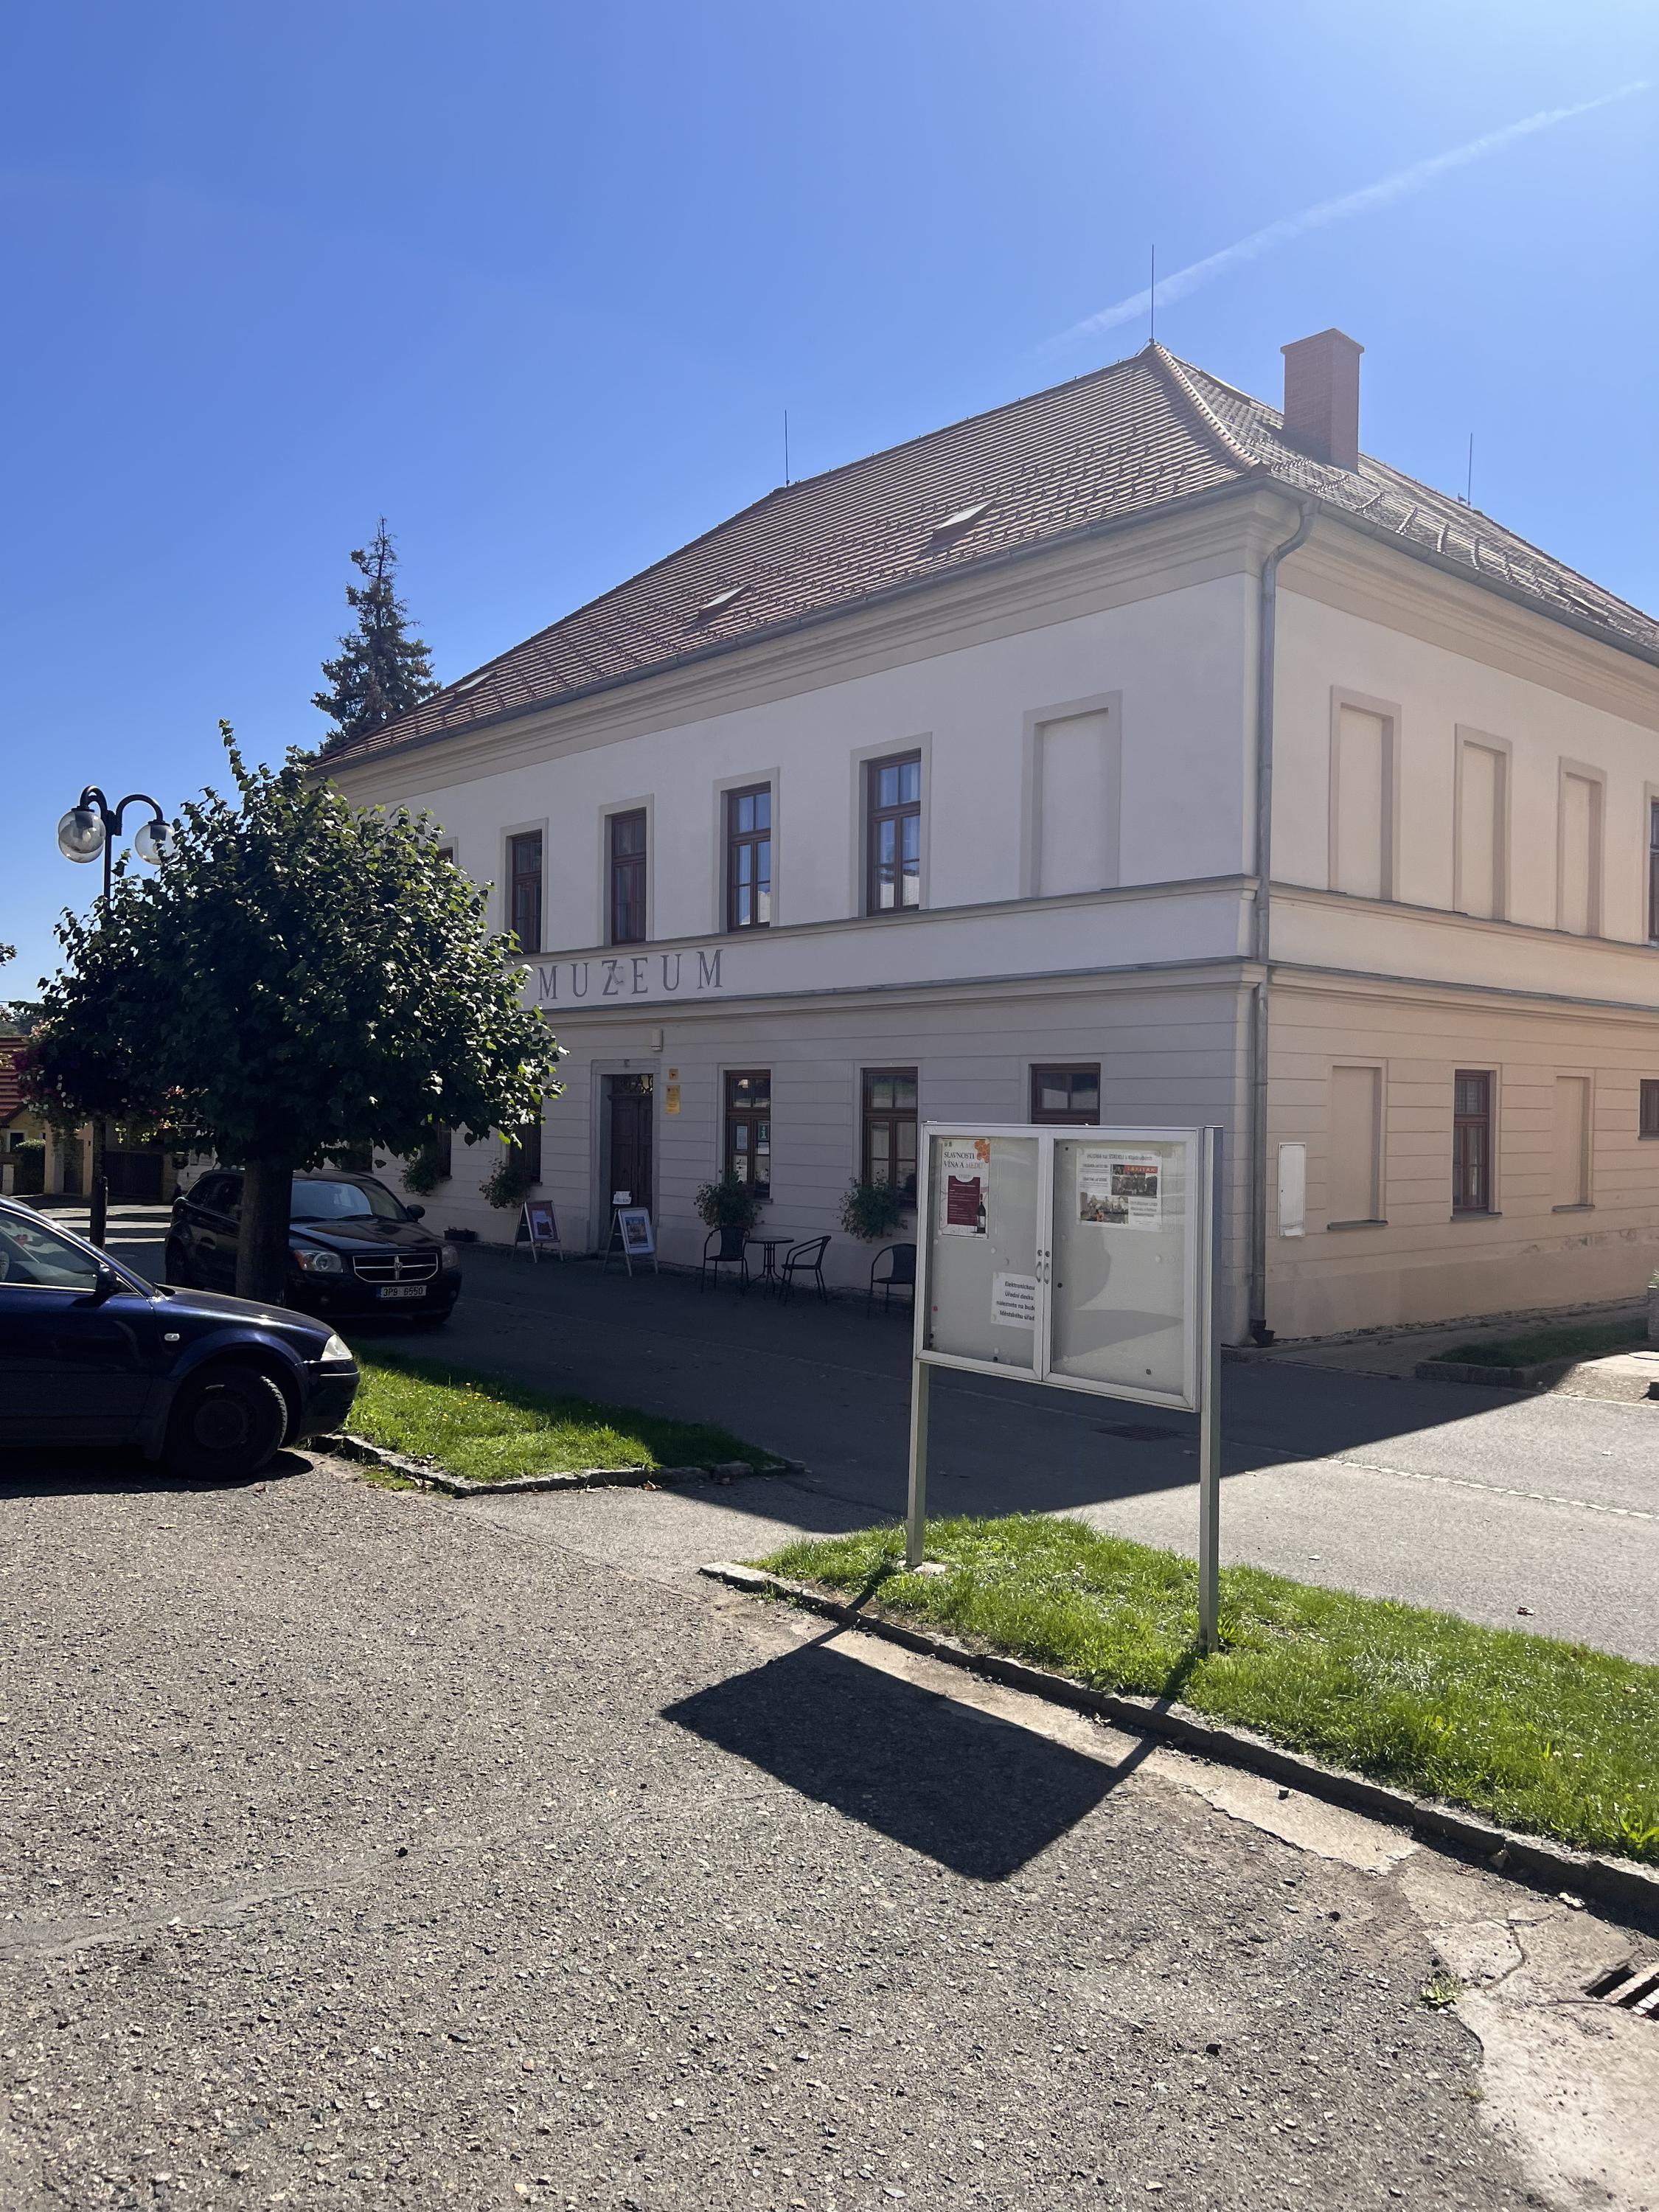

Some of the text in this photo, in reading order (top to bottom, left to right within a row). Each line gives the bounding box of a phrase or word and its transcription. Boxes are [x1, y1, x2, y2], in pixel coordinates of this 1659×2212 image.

[538, 949, 724, 1001] MUZEUM
[944, 1152, 975, 1160] SLAVNOSTI
[944, 1160, 960, 1169] VÍNA
